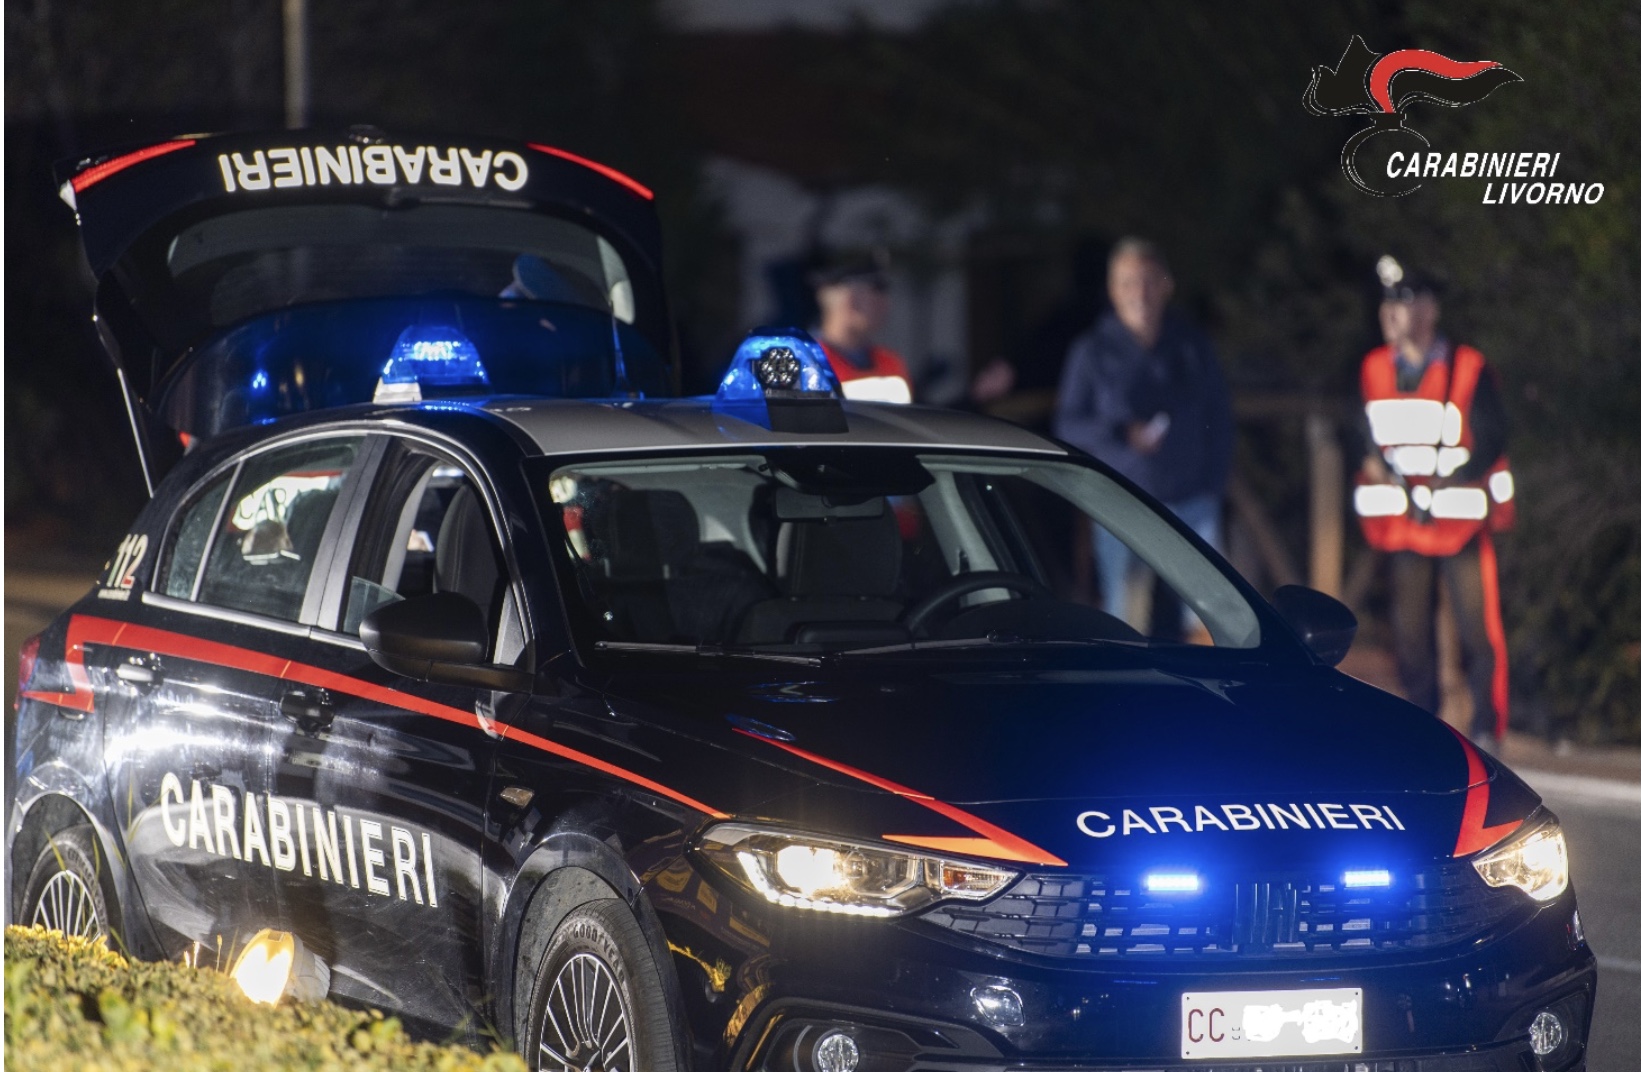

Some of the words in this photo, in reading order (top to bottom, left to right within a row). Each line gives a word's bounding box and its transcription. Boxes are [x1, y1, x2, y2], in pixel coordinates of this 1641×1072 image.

[218, 145, 529, 193] CARABINIERI
[106, 533, 149, 589] 112
[160, 771, 438, 908] CARABINIERI
[1076, 803, 1406, 838] CARABINIERI
[1187, 1007, 1225, 1043] CC
